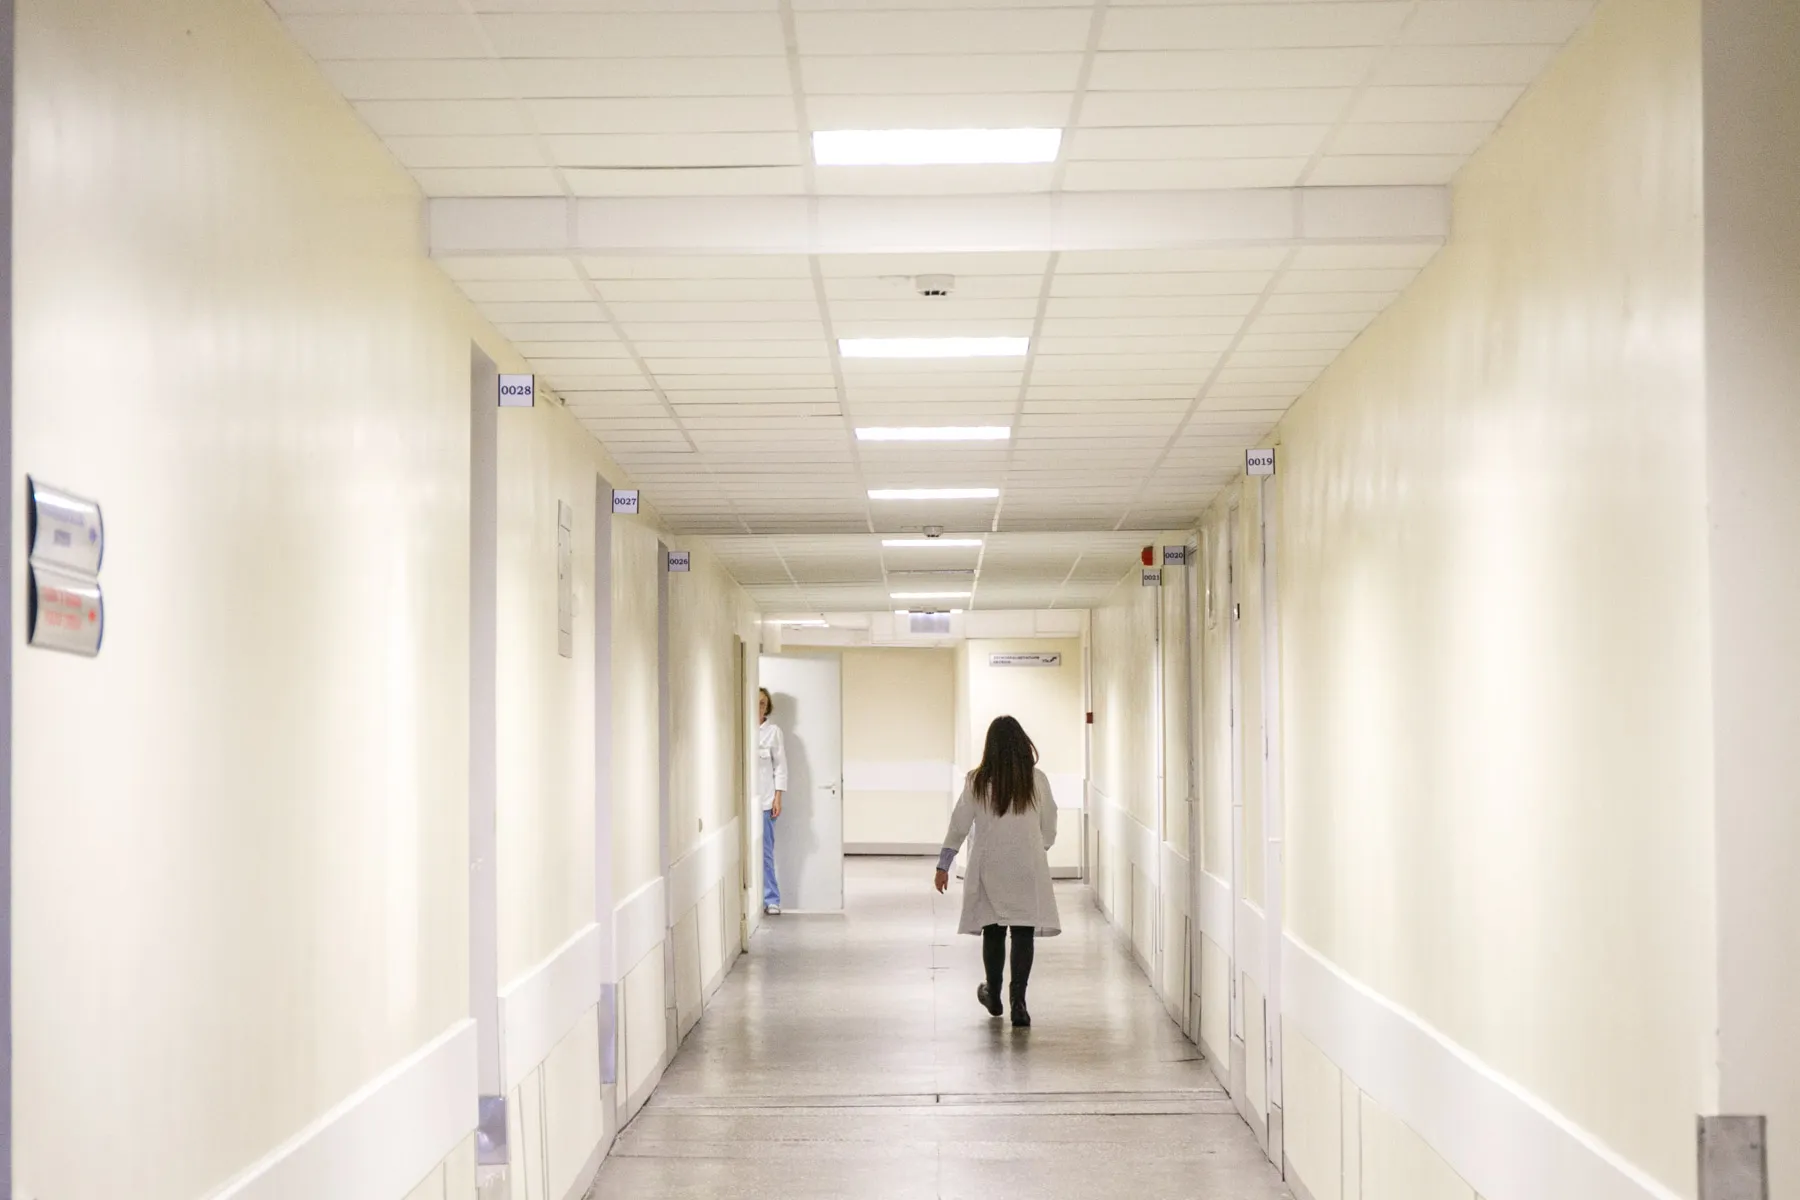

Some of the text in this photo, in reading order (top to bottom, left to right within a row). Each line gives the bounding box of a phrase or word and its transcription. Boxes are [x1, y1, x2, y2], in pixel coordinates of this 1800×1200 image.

[501, 385, 531, 395] 0028
[1248, 457, 1273, 466] 0019
[614, 497, 637, 505] 0027
